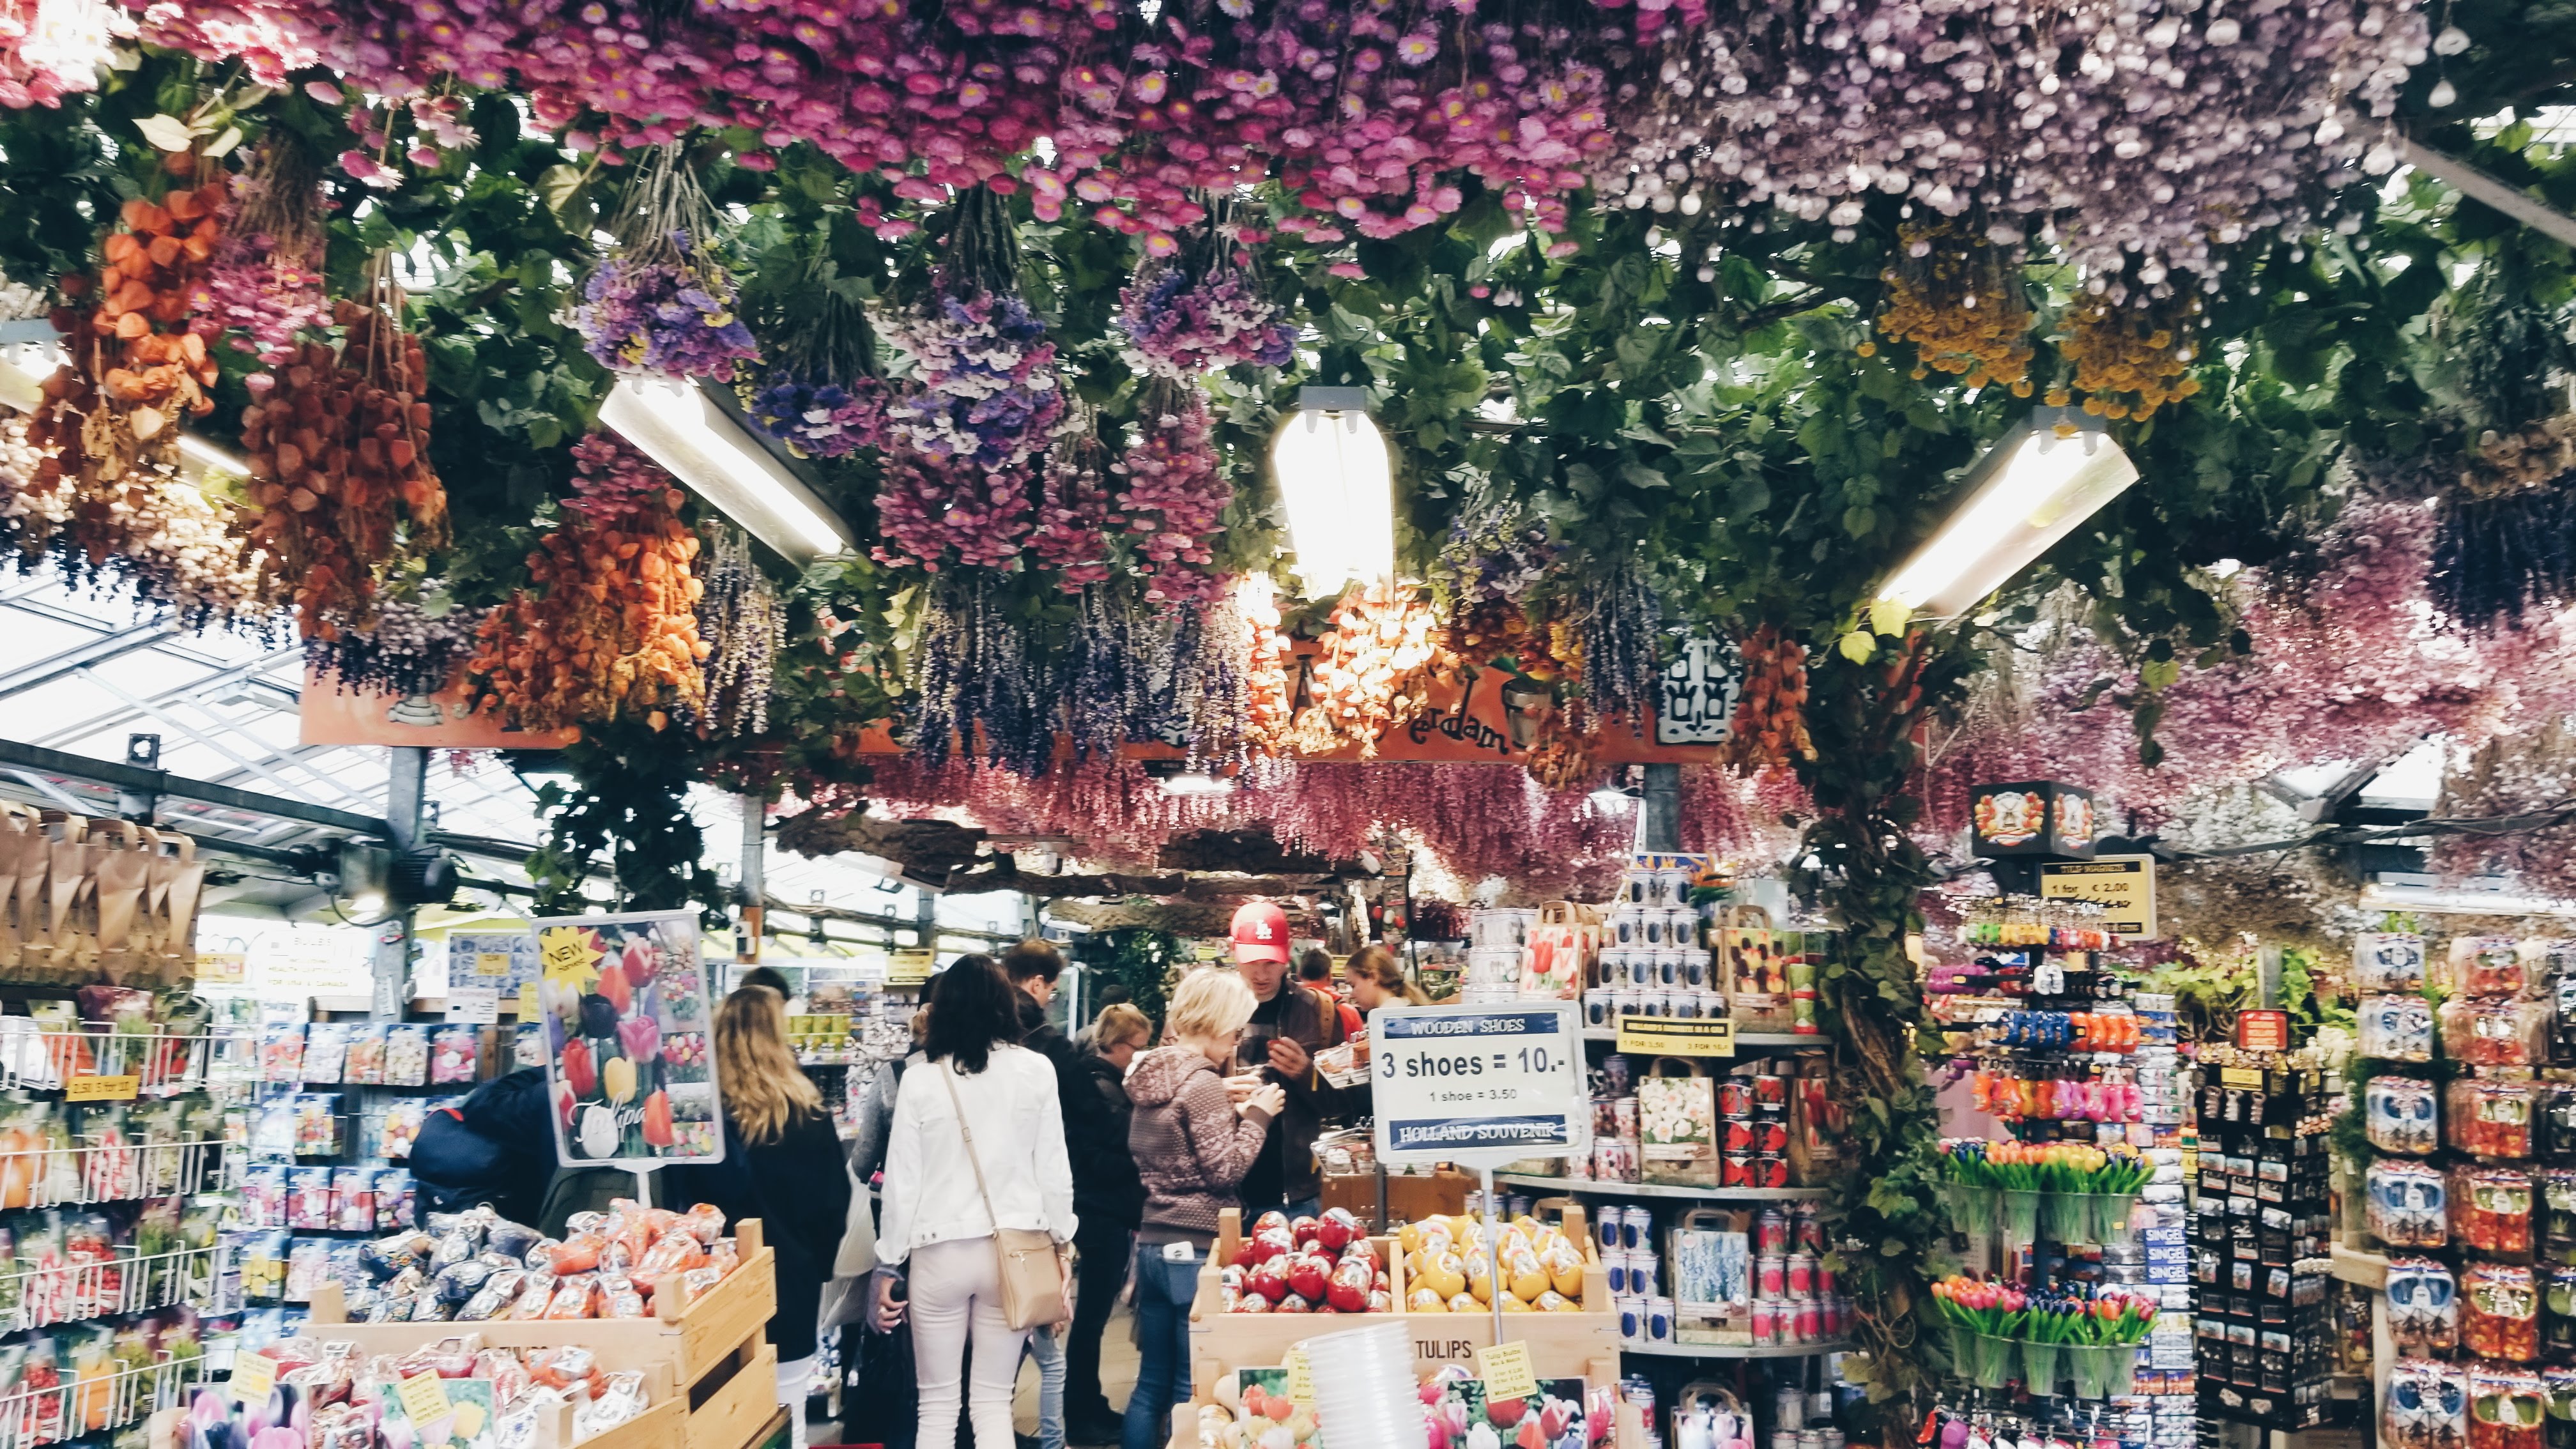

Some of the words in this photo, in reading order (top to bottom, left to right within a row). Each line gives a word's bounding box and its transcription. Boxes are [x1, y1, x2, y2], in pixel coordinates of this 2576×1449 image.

[2052, 884, 2058, 893] 1
[2062, 884, 2078, 893] for
[1255, 919, 1273, 940] LA
[548, 940, 582, 965] NEW
[1410, 1020, 1474, 1035] WOODEN
[1480, 1018, 1526, 1034] SHOES
[1381, 1052, 1395, 1078] 3
[1406, 1051, 1483, 1077] shoes
[1493, 1054, 1506, 1069] =
[1430, 1091, 1436, 1102] 1
[1442, 1090, 1473, 1101] shoe
[1489, 1089, 1517, 1100] 3.50
[1399, 1124, 1474, 1143] HOLLAND
[1477, 1122, 1557, 1140] SOUVENIR
[2145, 1229, 2185, 1241] SINGEL
[2148, 1247, 2188, 1261] SINGEL
[2149, 1266, 2188, 1279] SINGEL
[1415, 1340, 1472, 1359] TULIPS
